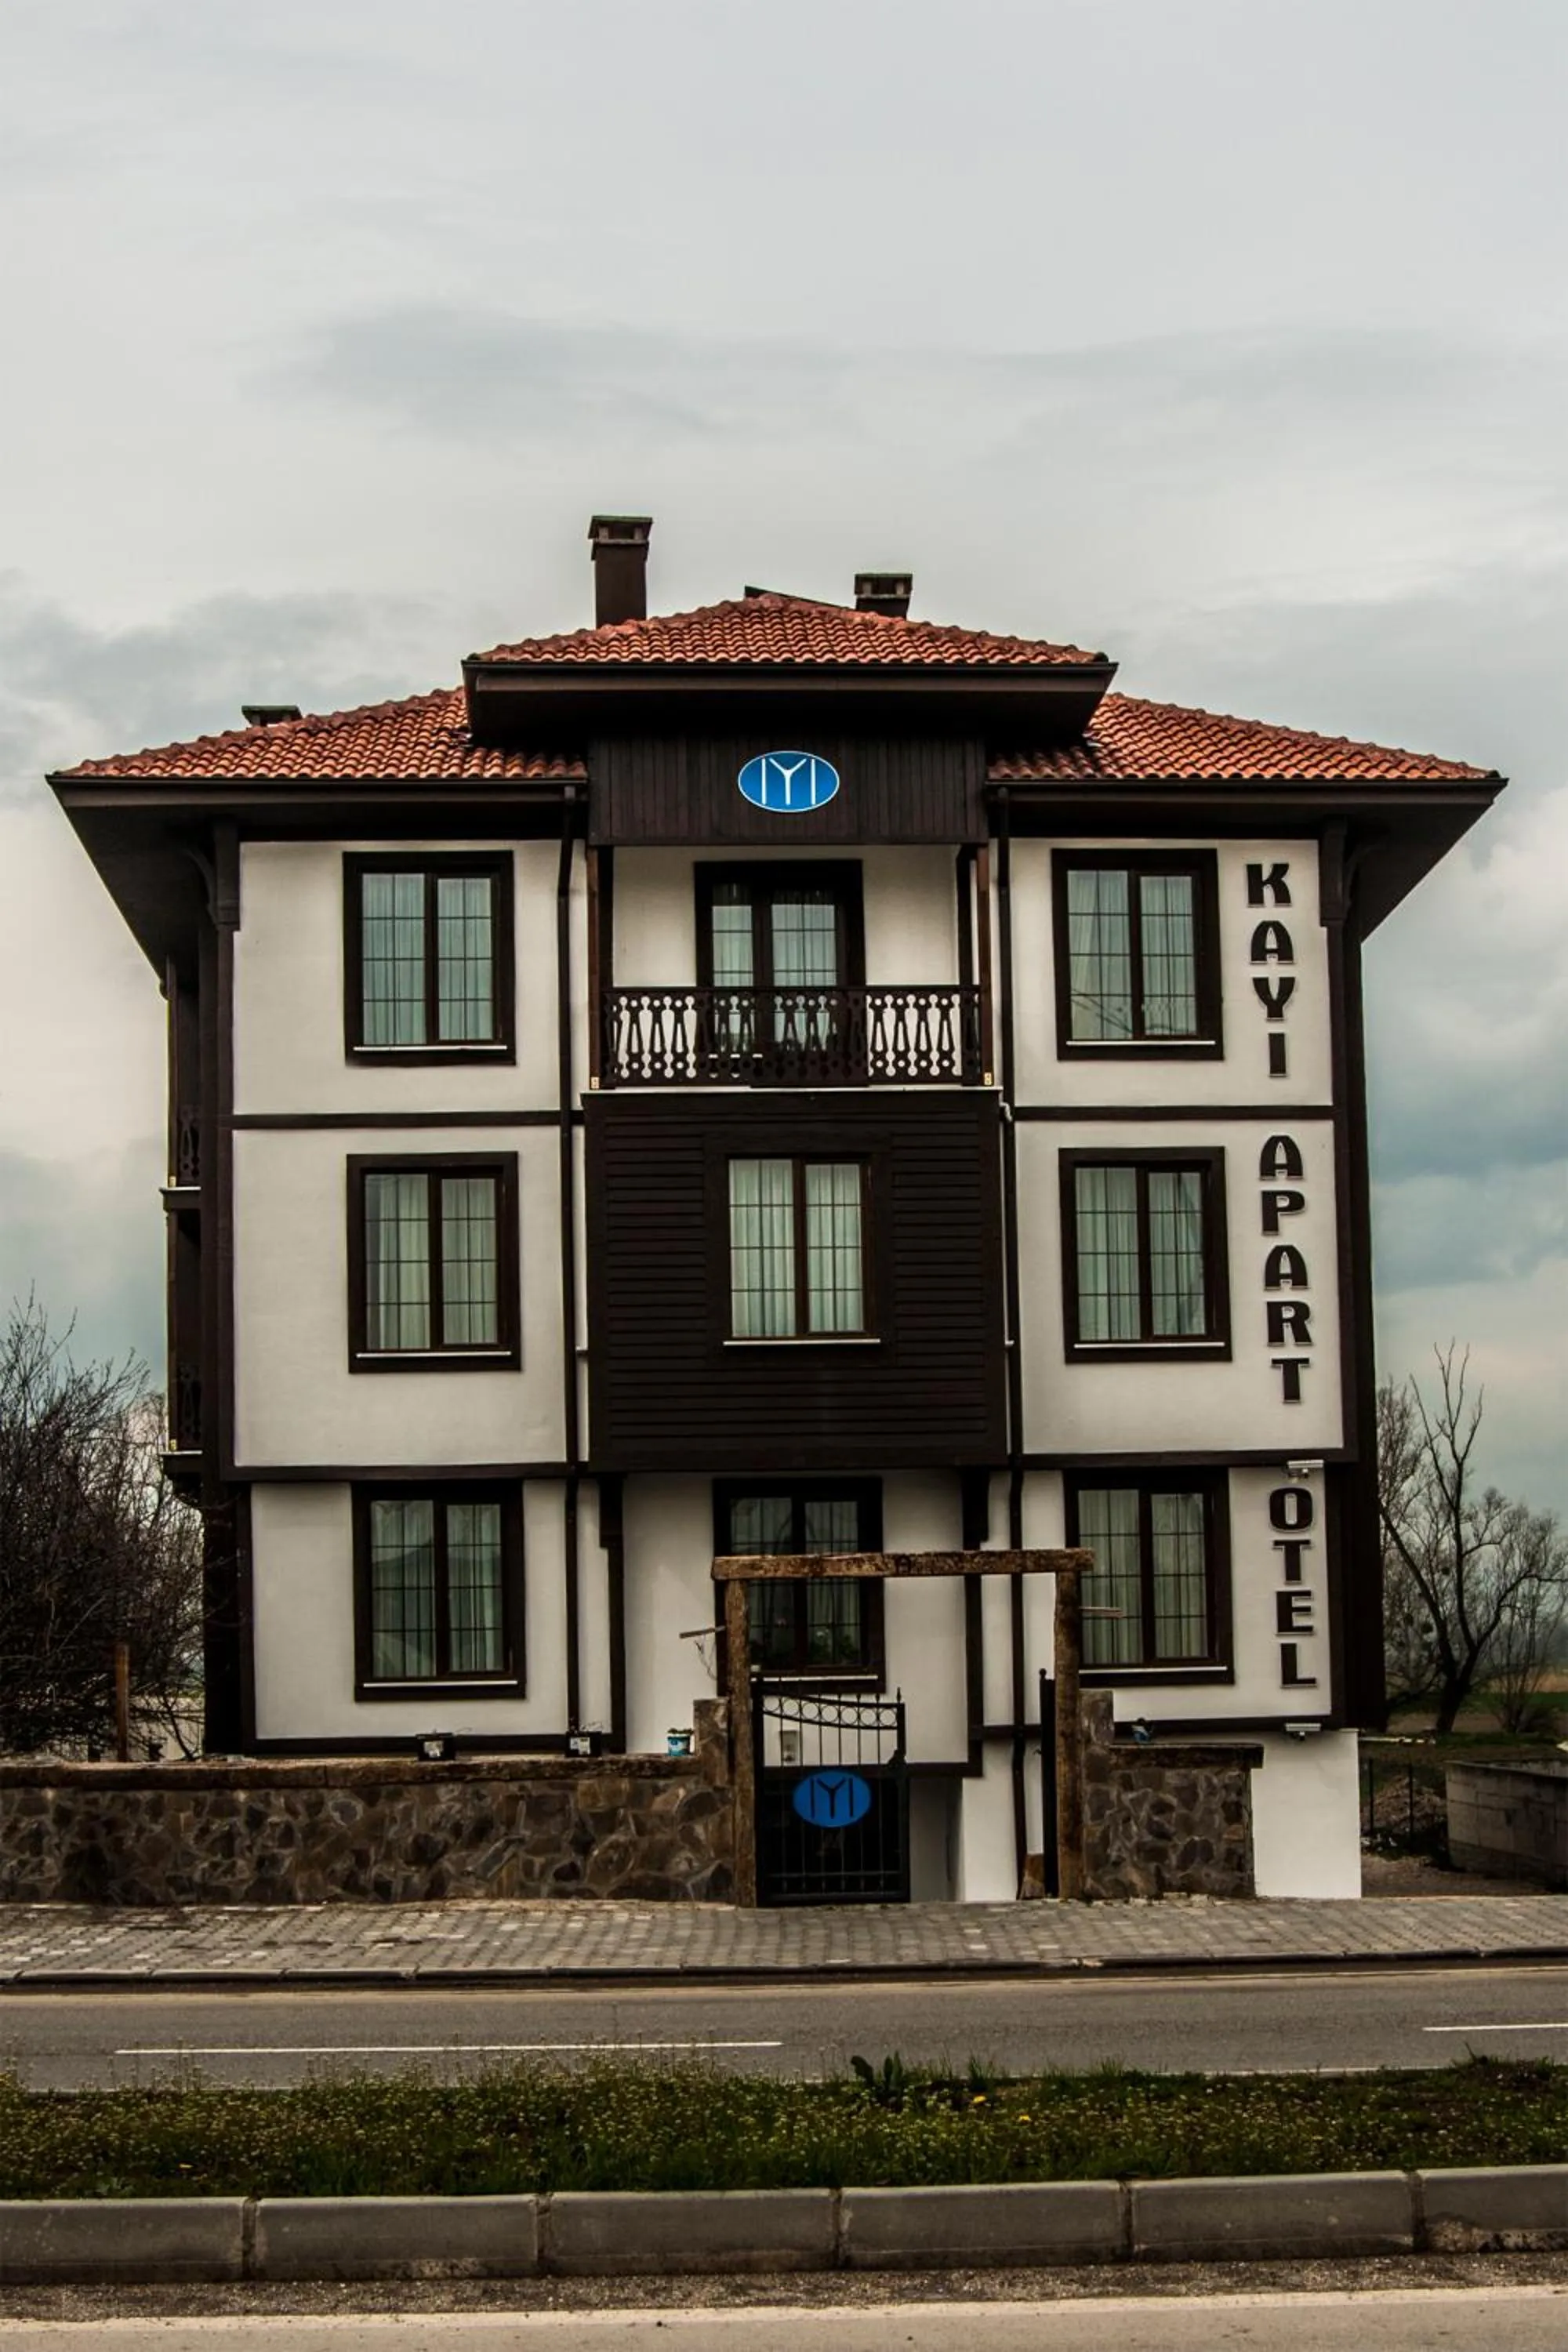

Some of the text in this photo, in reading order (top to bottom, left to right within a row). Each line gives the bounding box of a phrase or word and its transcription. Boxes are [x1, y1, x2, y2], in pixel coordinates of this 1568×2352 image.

[1246, 862, 1317, 1689] KAYI APART OTEL
